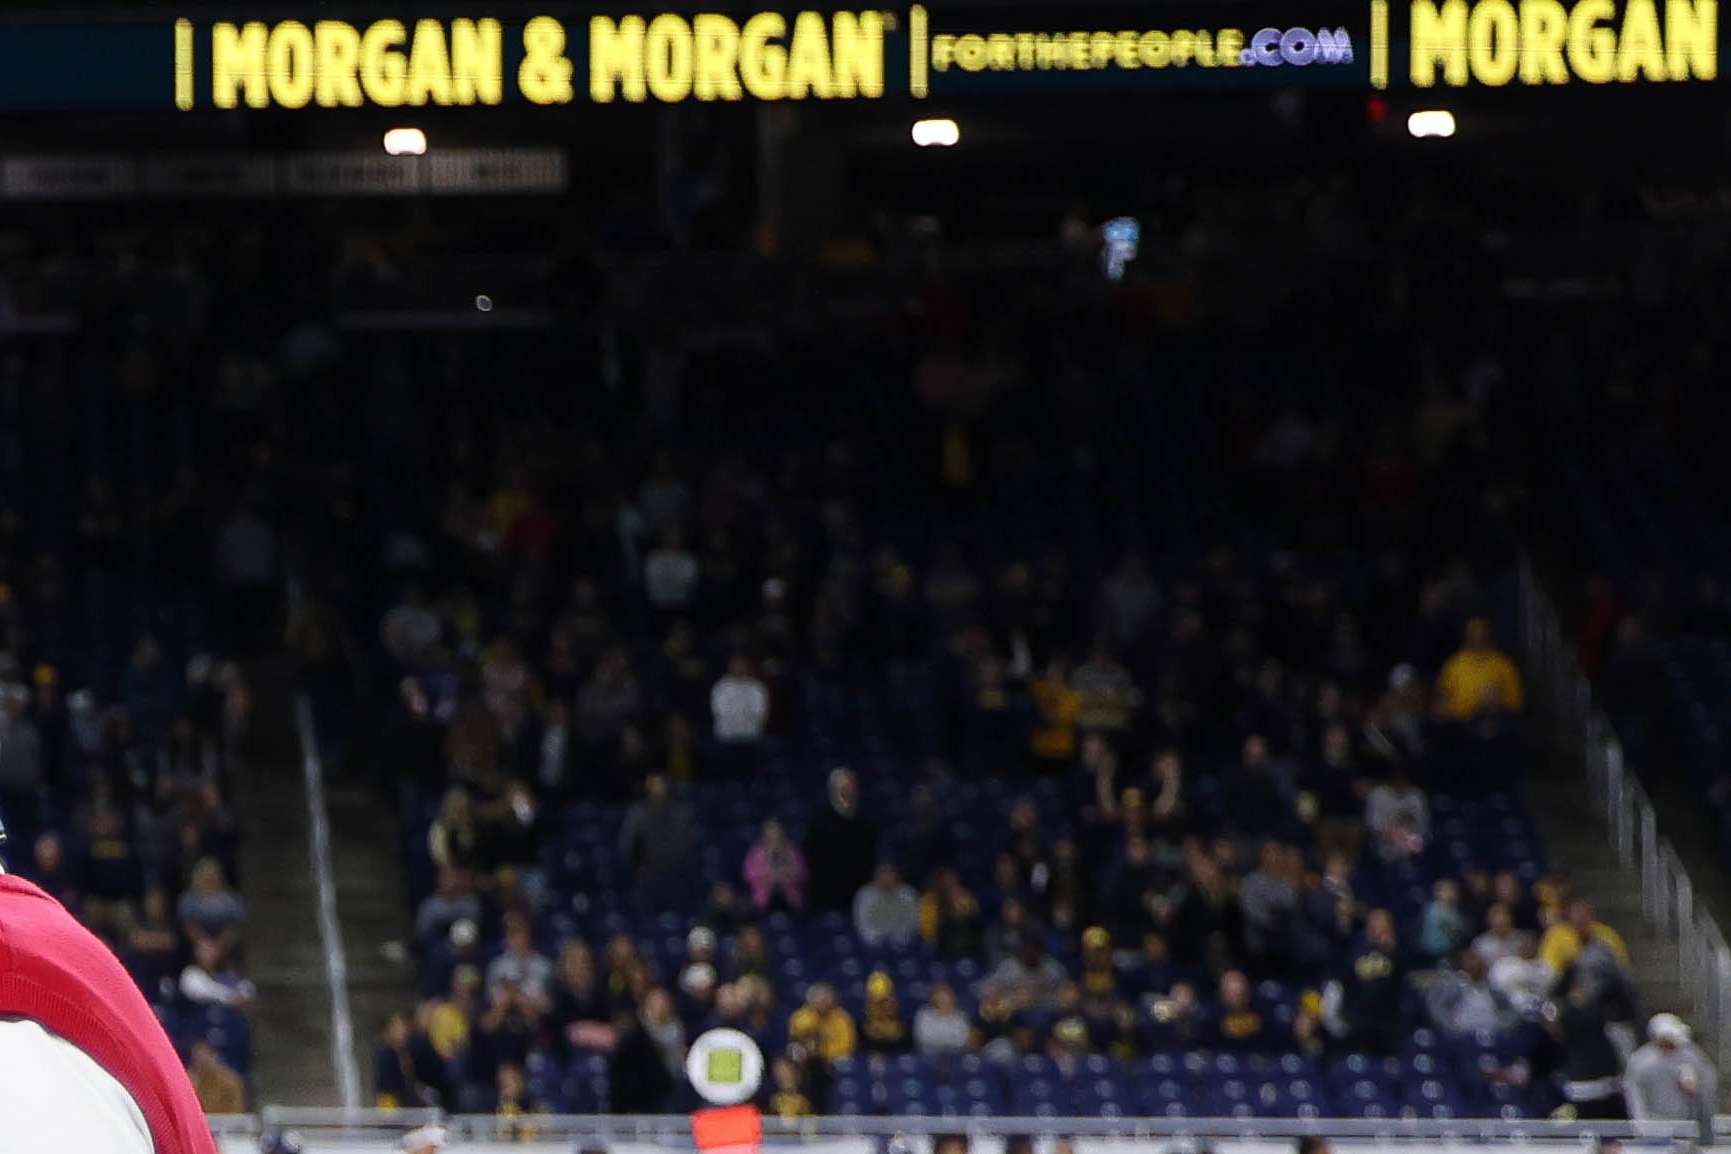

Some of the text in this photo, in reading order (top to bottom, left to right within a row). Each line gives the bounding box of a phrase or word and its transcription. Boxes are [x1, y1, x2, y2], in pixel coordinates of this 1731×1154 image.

[212, 10, 884, 109] MORGAN & MORGAN
[932, 27, 1354, 71] FORTHEPEOPLE.COM
[1410, 0, 1718, 88] MORGAN
